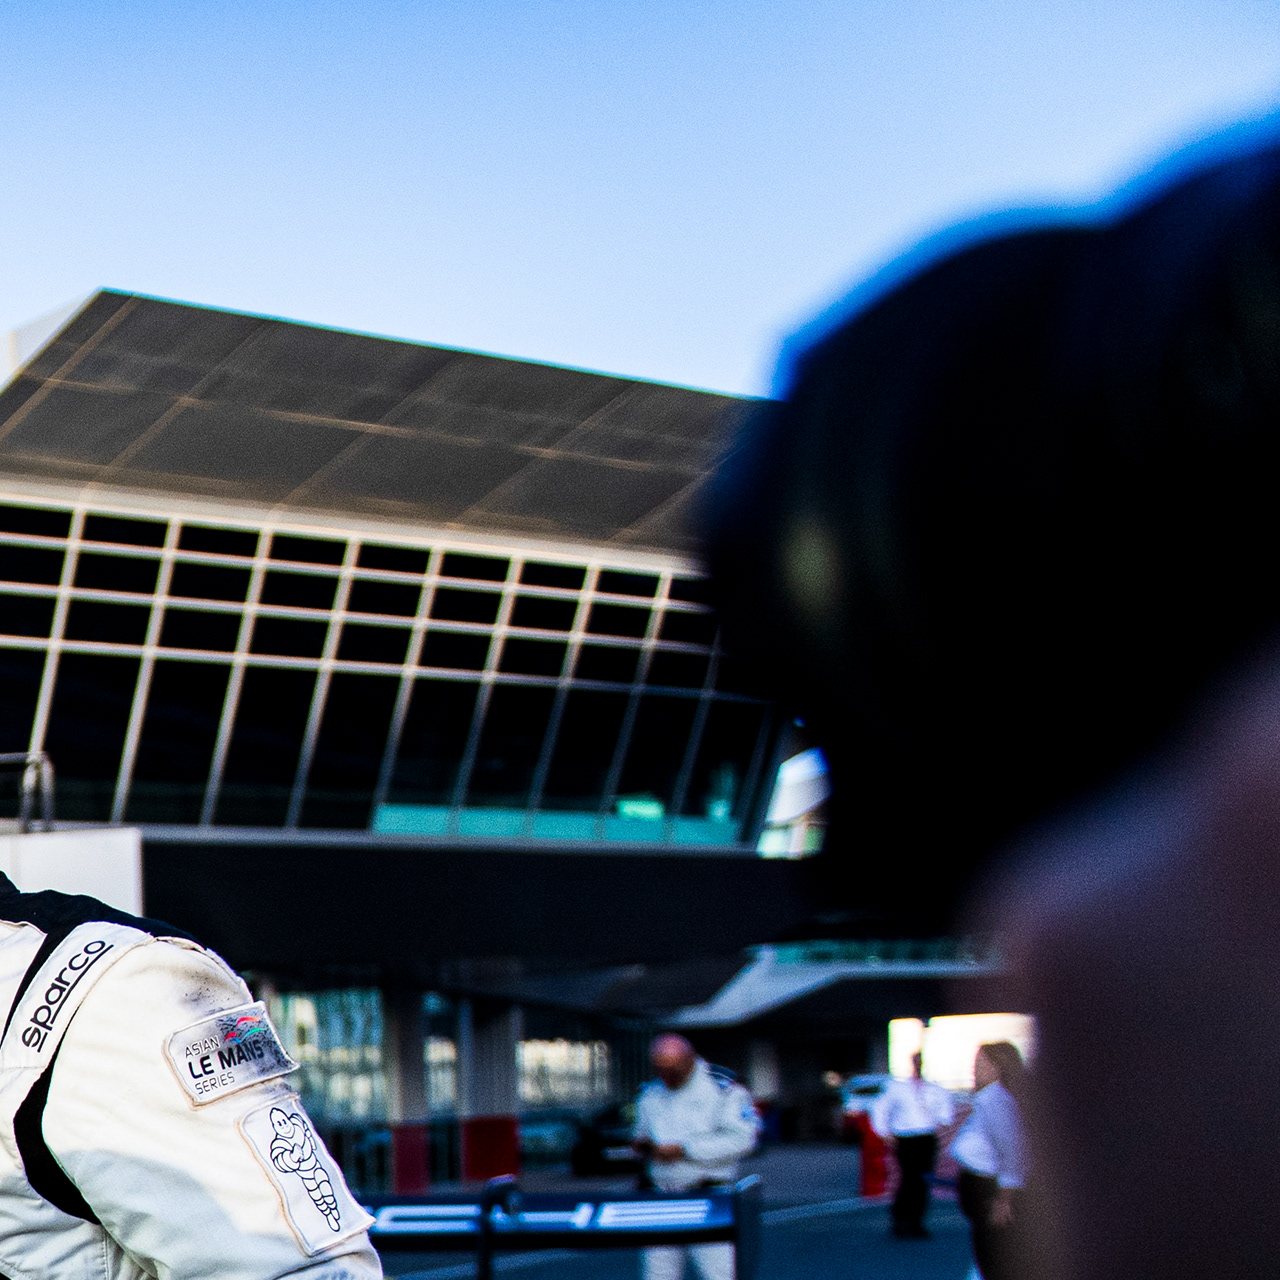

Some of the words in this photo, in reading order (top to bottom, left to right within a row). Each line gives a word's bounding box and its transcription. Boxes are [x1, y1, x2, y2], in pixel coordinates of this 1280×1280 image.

[21, 940, 114, 1053] sparco
[184, 1035, 220, 1059] ASIAN
[189, 1056, 215, 1080] LE
[217, 1039, 266, 1070] MANS
[194, 1071, 236, 1095] SERIES
